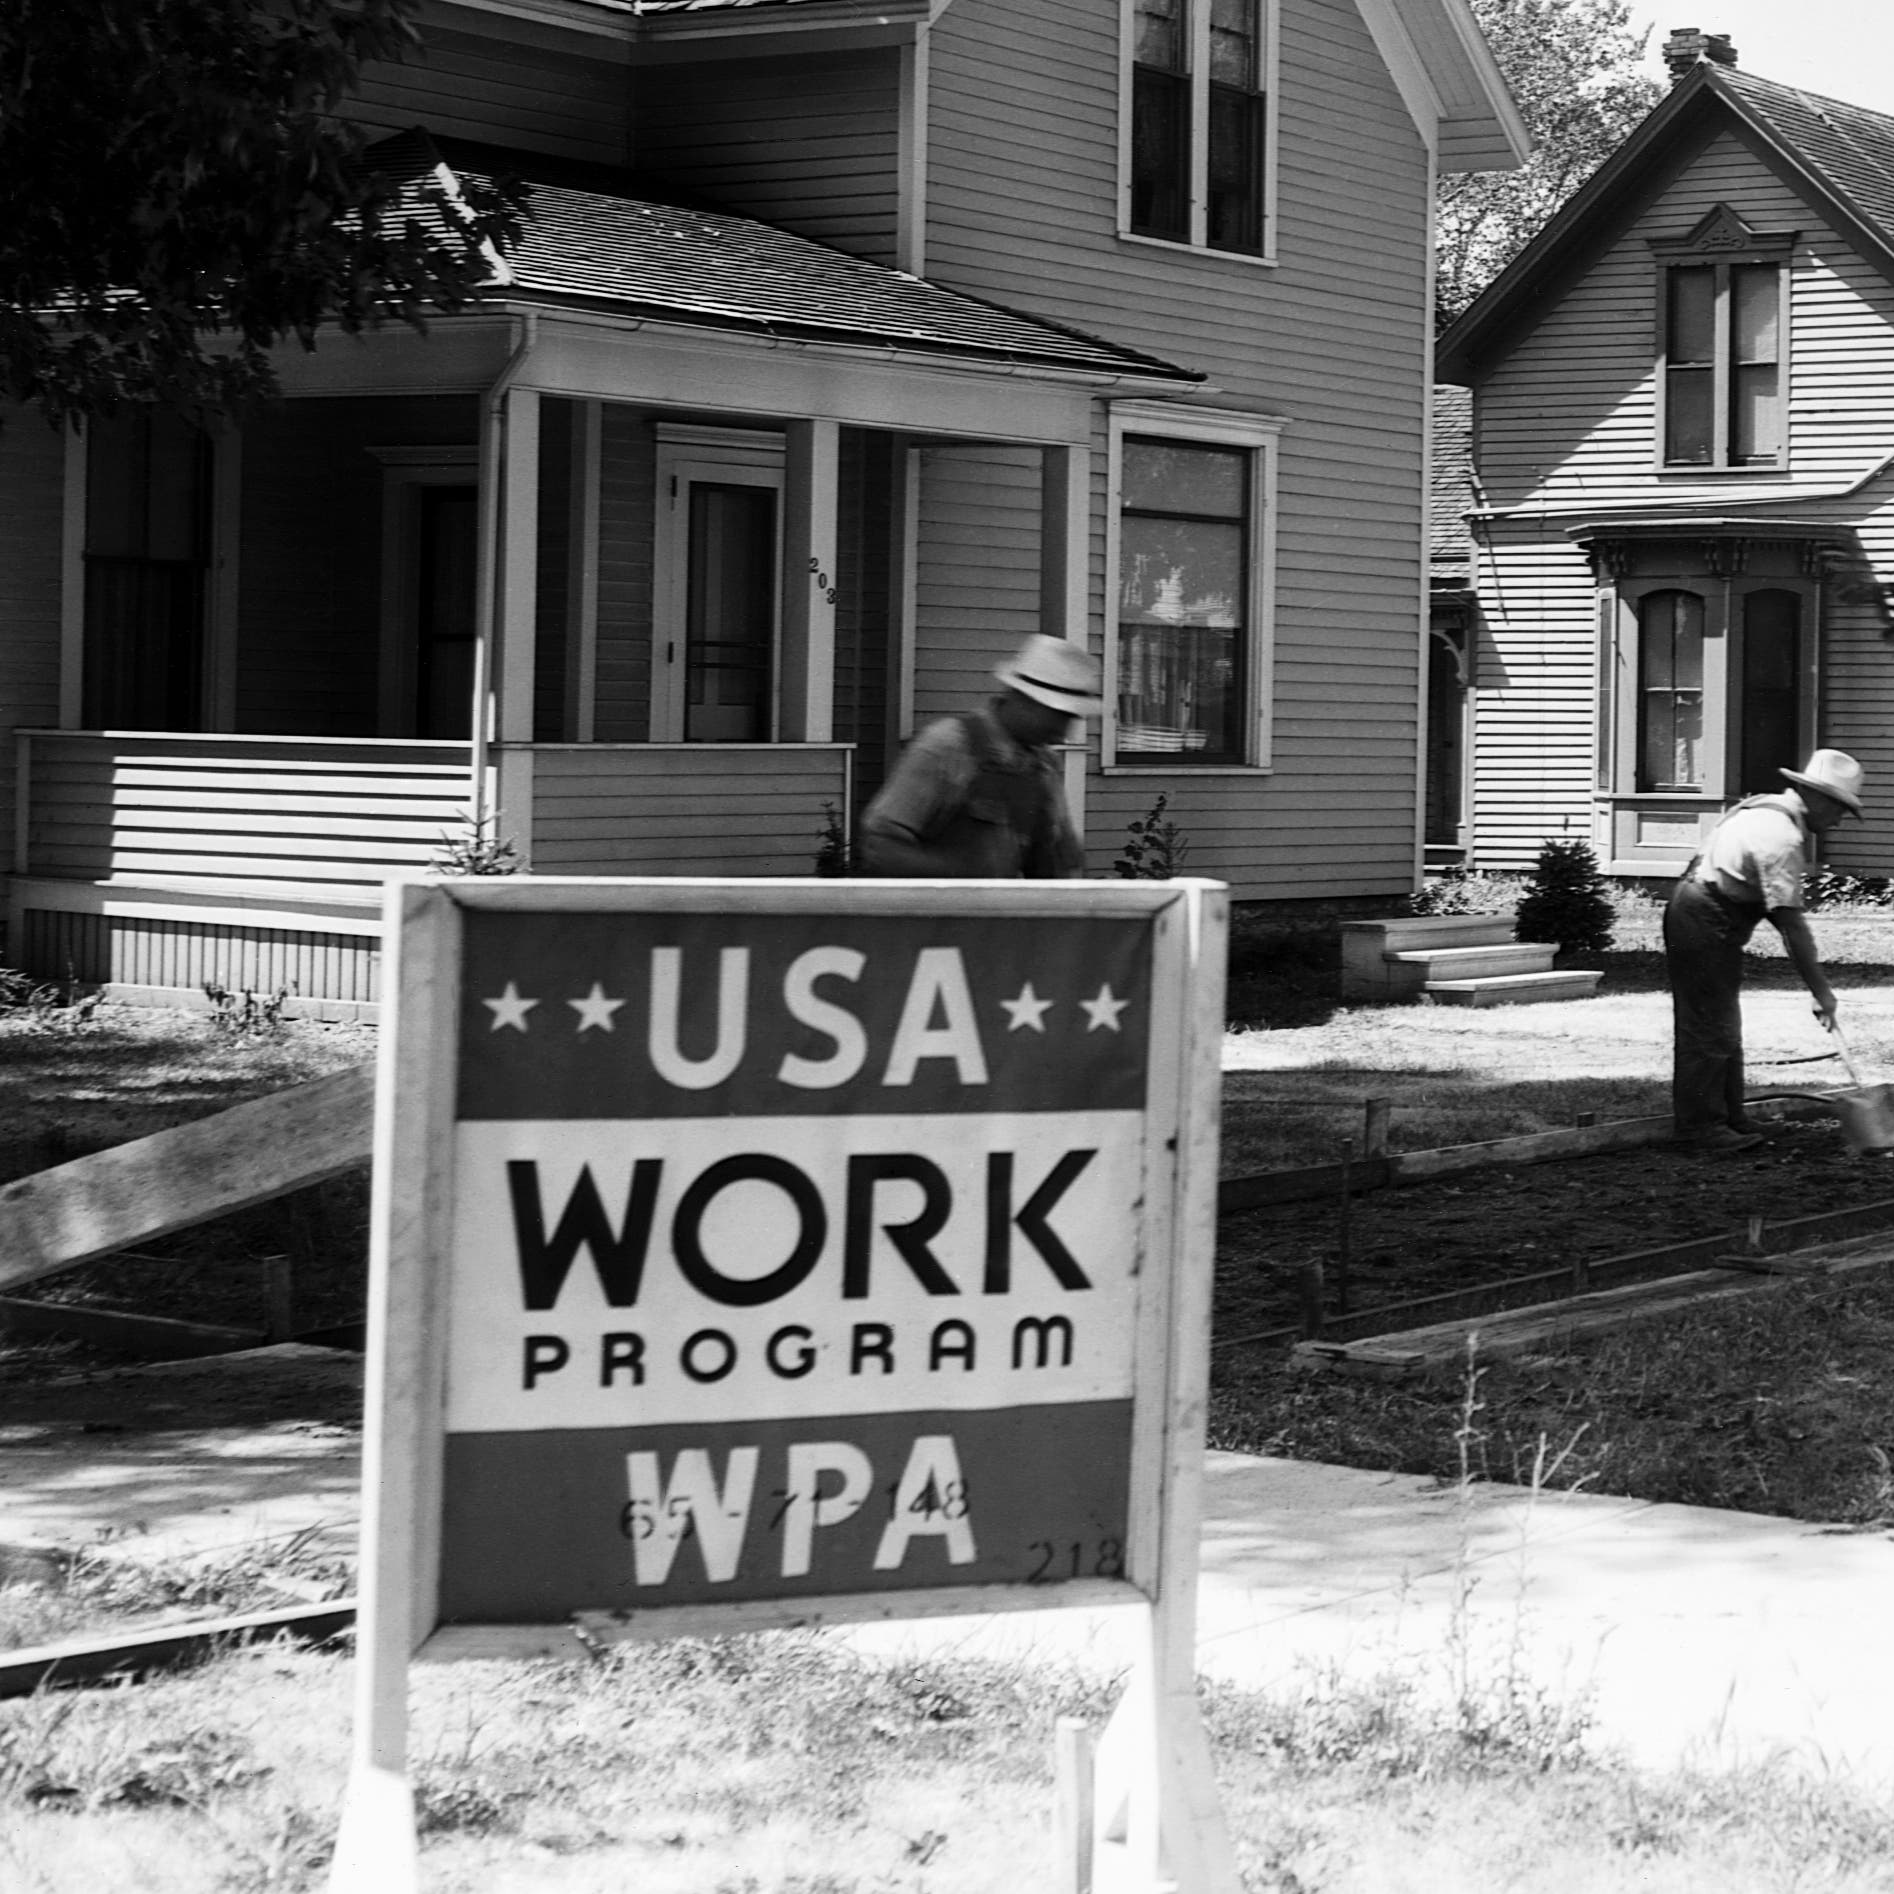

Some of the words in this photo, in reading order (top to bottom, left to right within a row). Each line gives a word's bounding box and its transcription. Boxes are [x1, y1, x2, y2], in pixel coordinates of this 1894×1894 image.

[809, 557, 837, 604] 203
[650, 947, 987, 1088] USA
[506, 1149, 1098, 1311] WORK
[523, 1314, 1073, 1390] PROGRAM
[627, 1436, 978, 1587] WPA
[1027, 1538, 1125, 1584] 218
